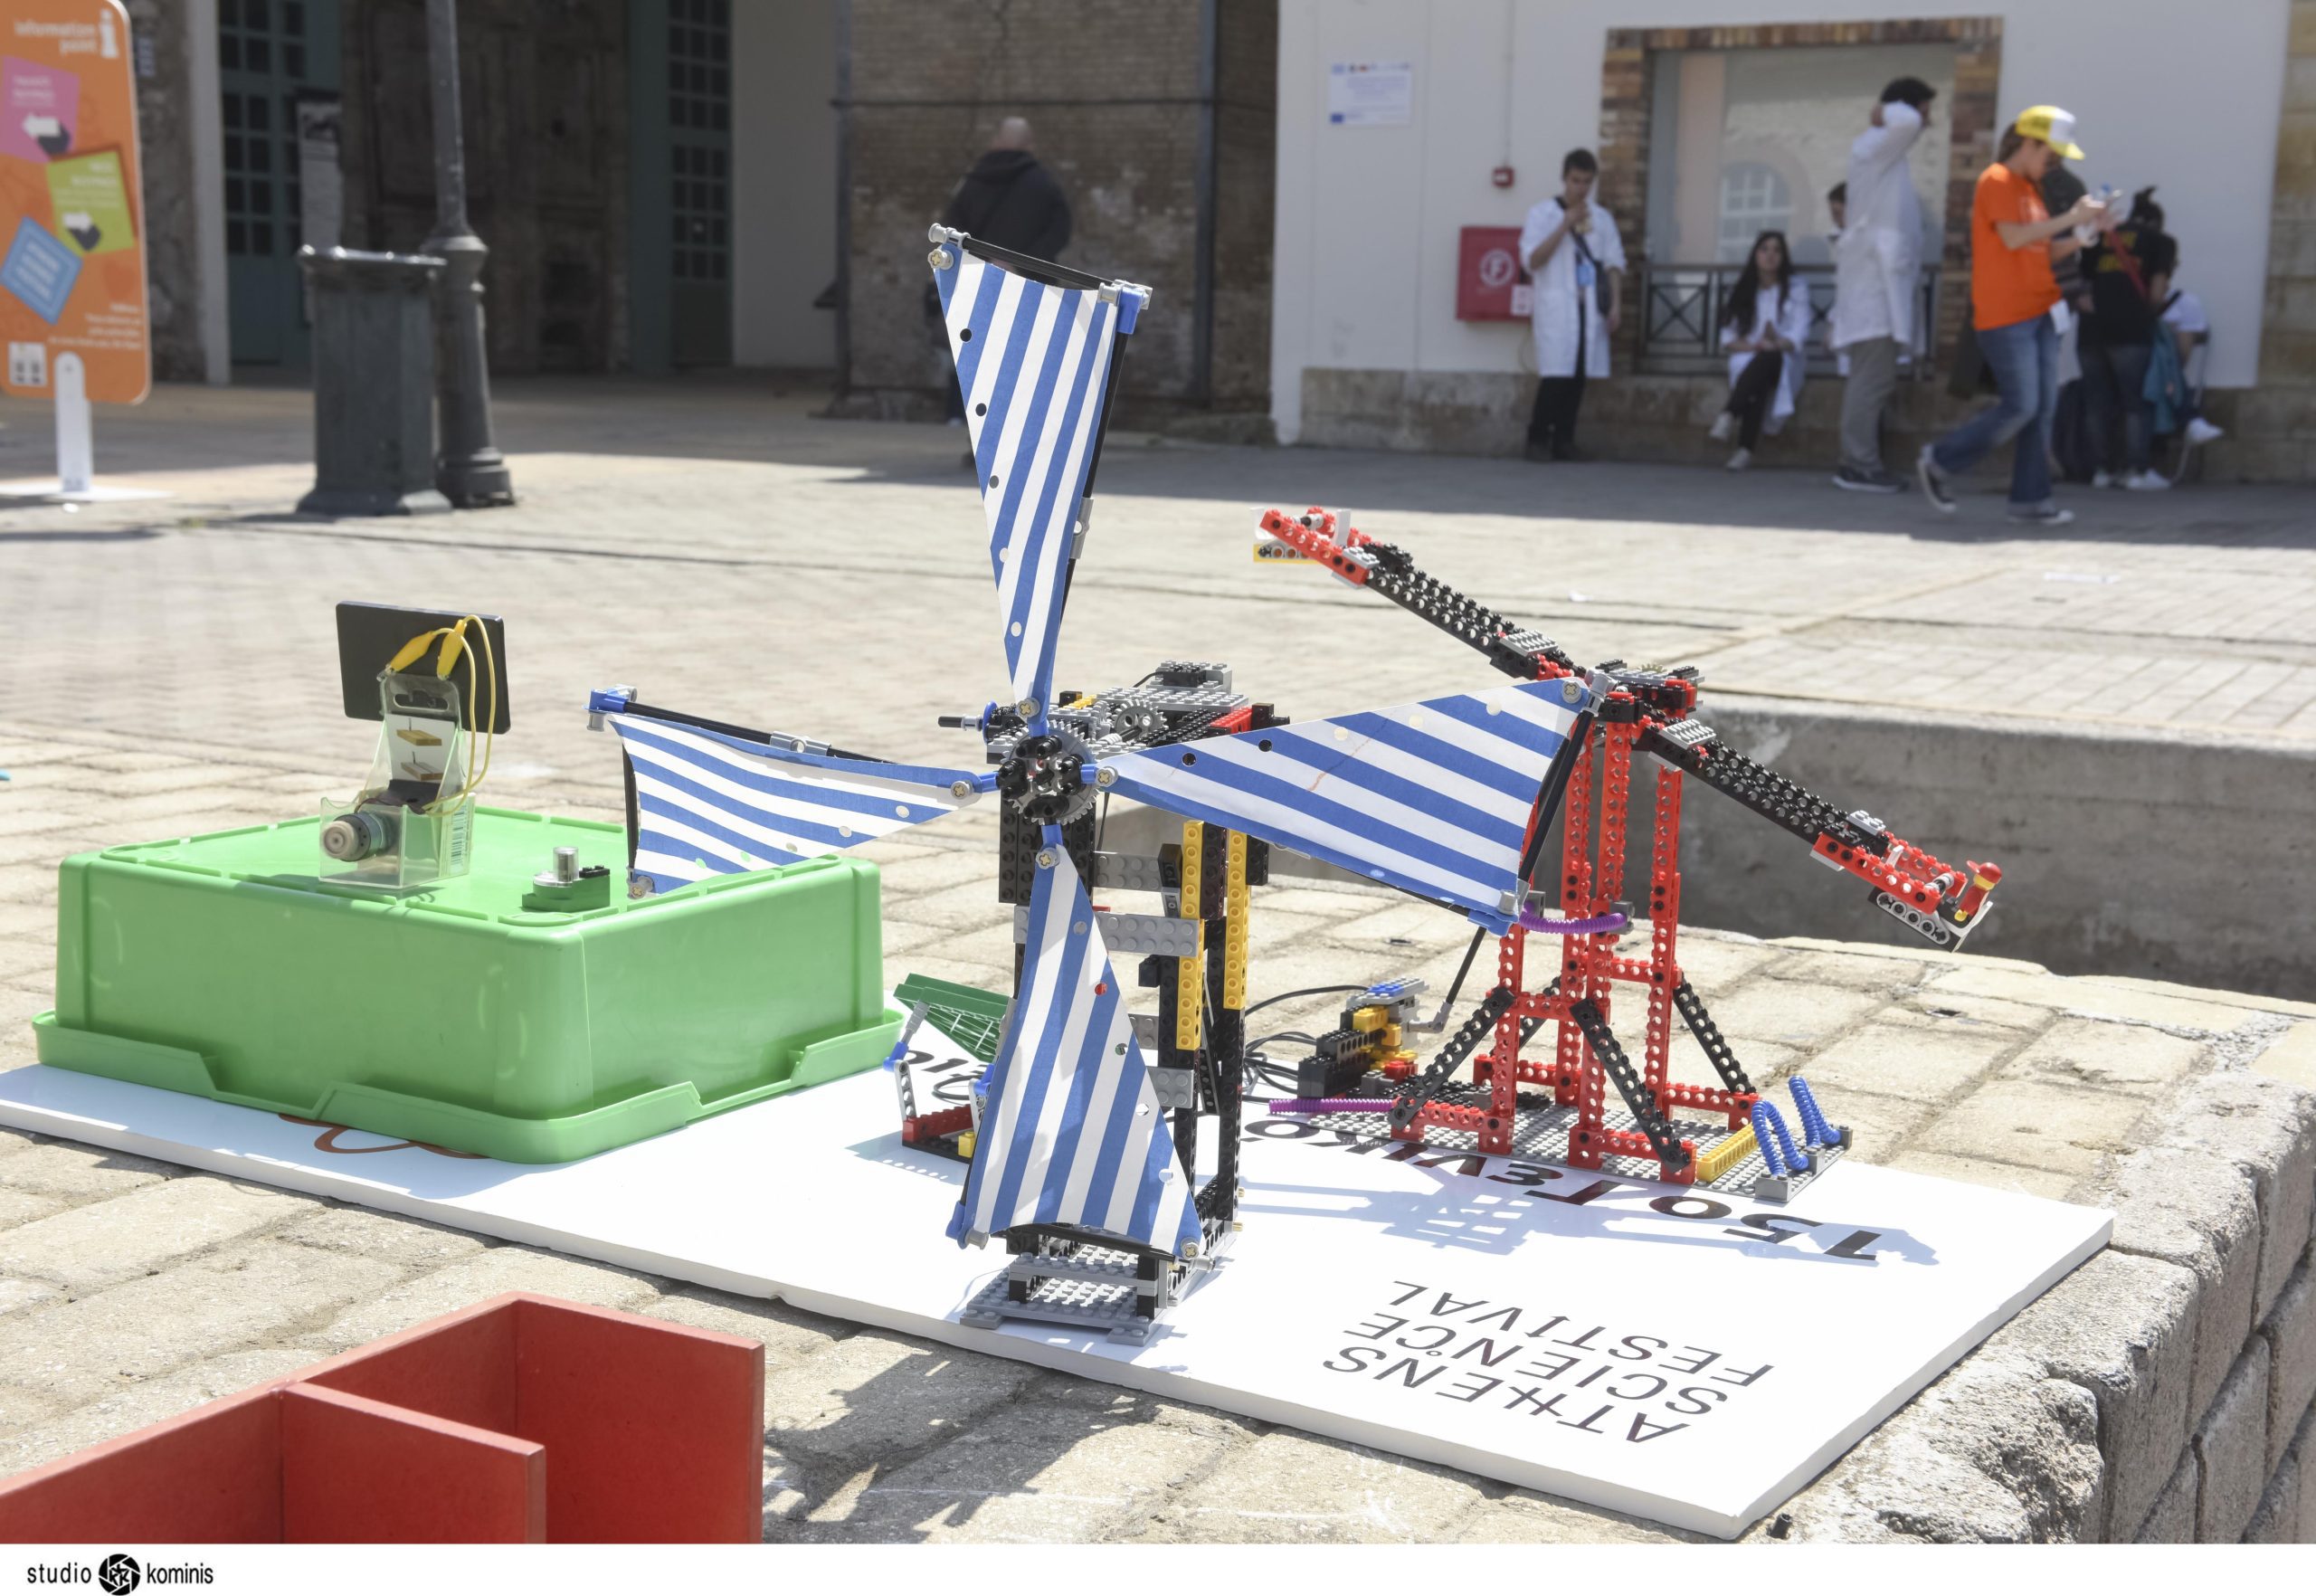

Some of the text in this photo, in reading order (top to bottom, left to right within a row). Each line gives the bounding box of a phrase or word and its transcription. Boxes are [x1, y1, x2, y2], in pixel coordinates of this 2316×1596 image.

[1343, 1313, 1728, 1415] SCIENCE
[1388, 1280, 1776, 1387] FESTIVAL
[1322, 1345, 1692, 1443] ATHENS
